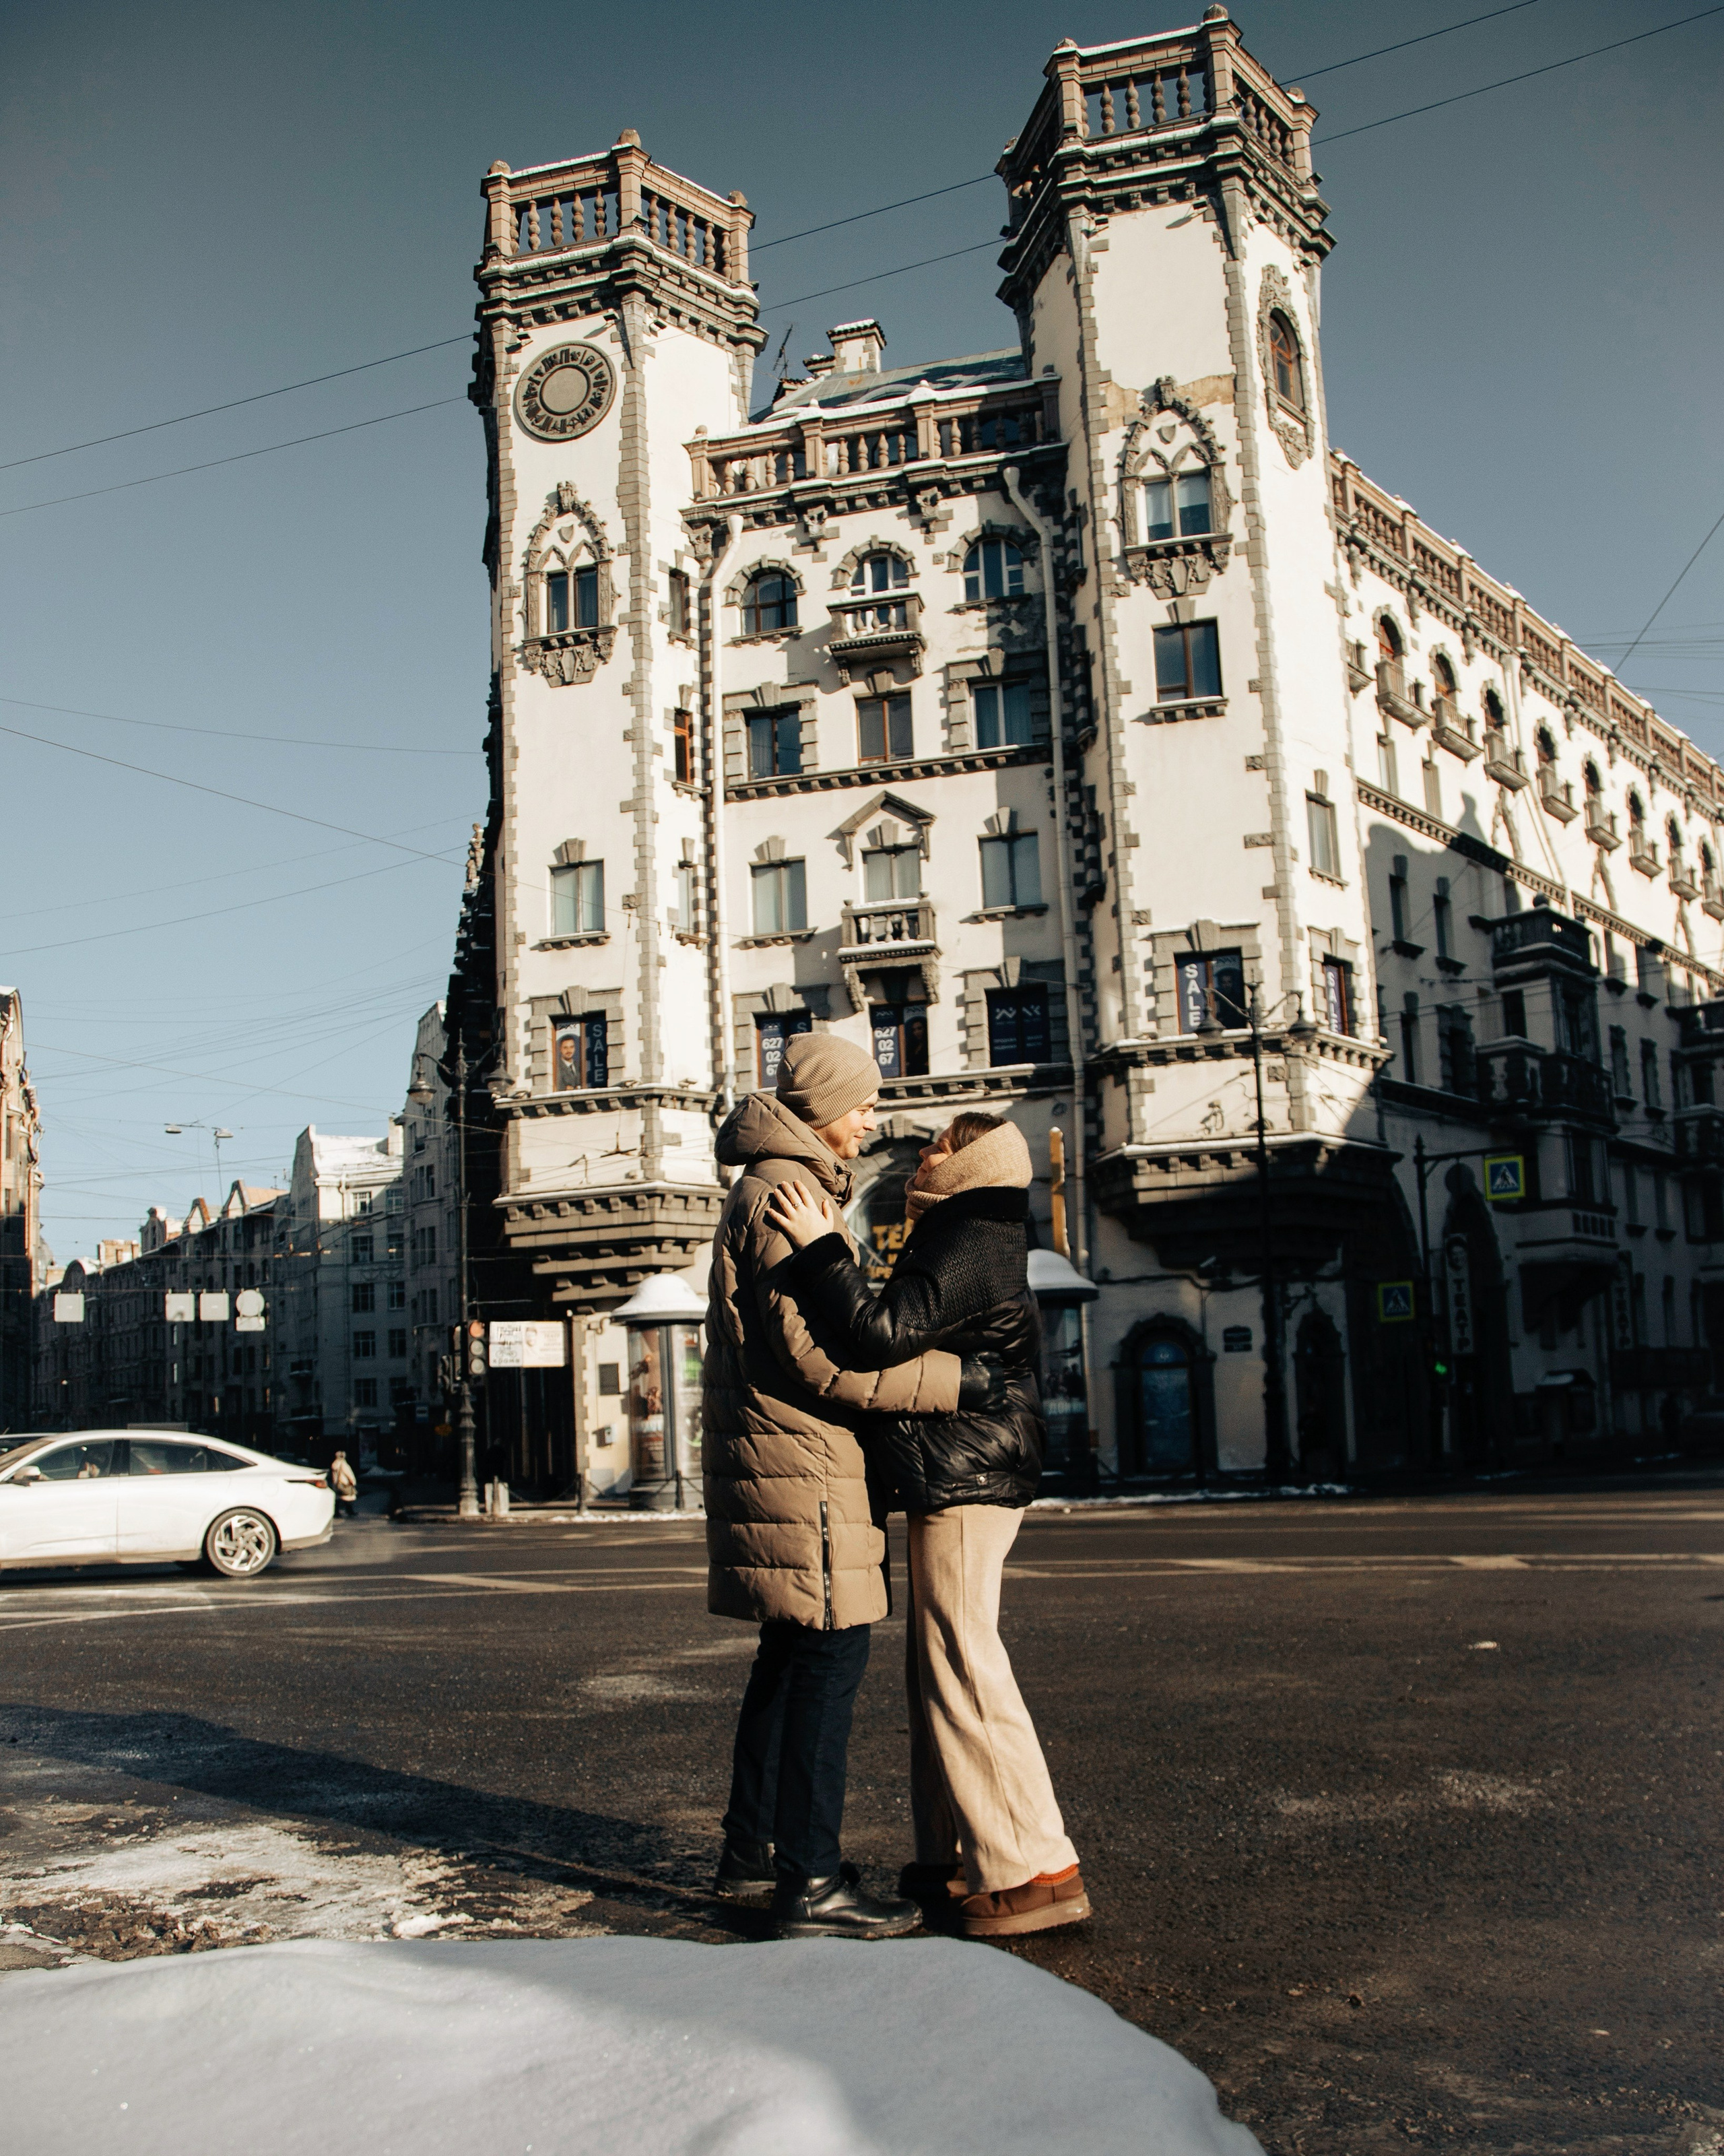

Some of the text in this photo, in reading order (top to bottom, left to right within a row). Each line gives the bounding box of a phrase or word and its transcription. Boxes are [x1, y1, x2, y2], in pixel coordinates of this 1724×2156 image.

[1184, 963, 1201, 1027] SALE
[1327, 971, 1338, 1033] SALE
[873, 1026, 897, 1038] 627
[762, 1037, 784, 1050] 627
[877, 1039, 894, 1051] 02
[593, 1024, 604, 1082] SALE
[766, 1051, 781, 1064] 02
[878, 1052, 895, 1065] 67
[1453, 1278, 1470, 1352] ТЕАТР
